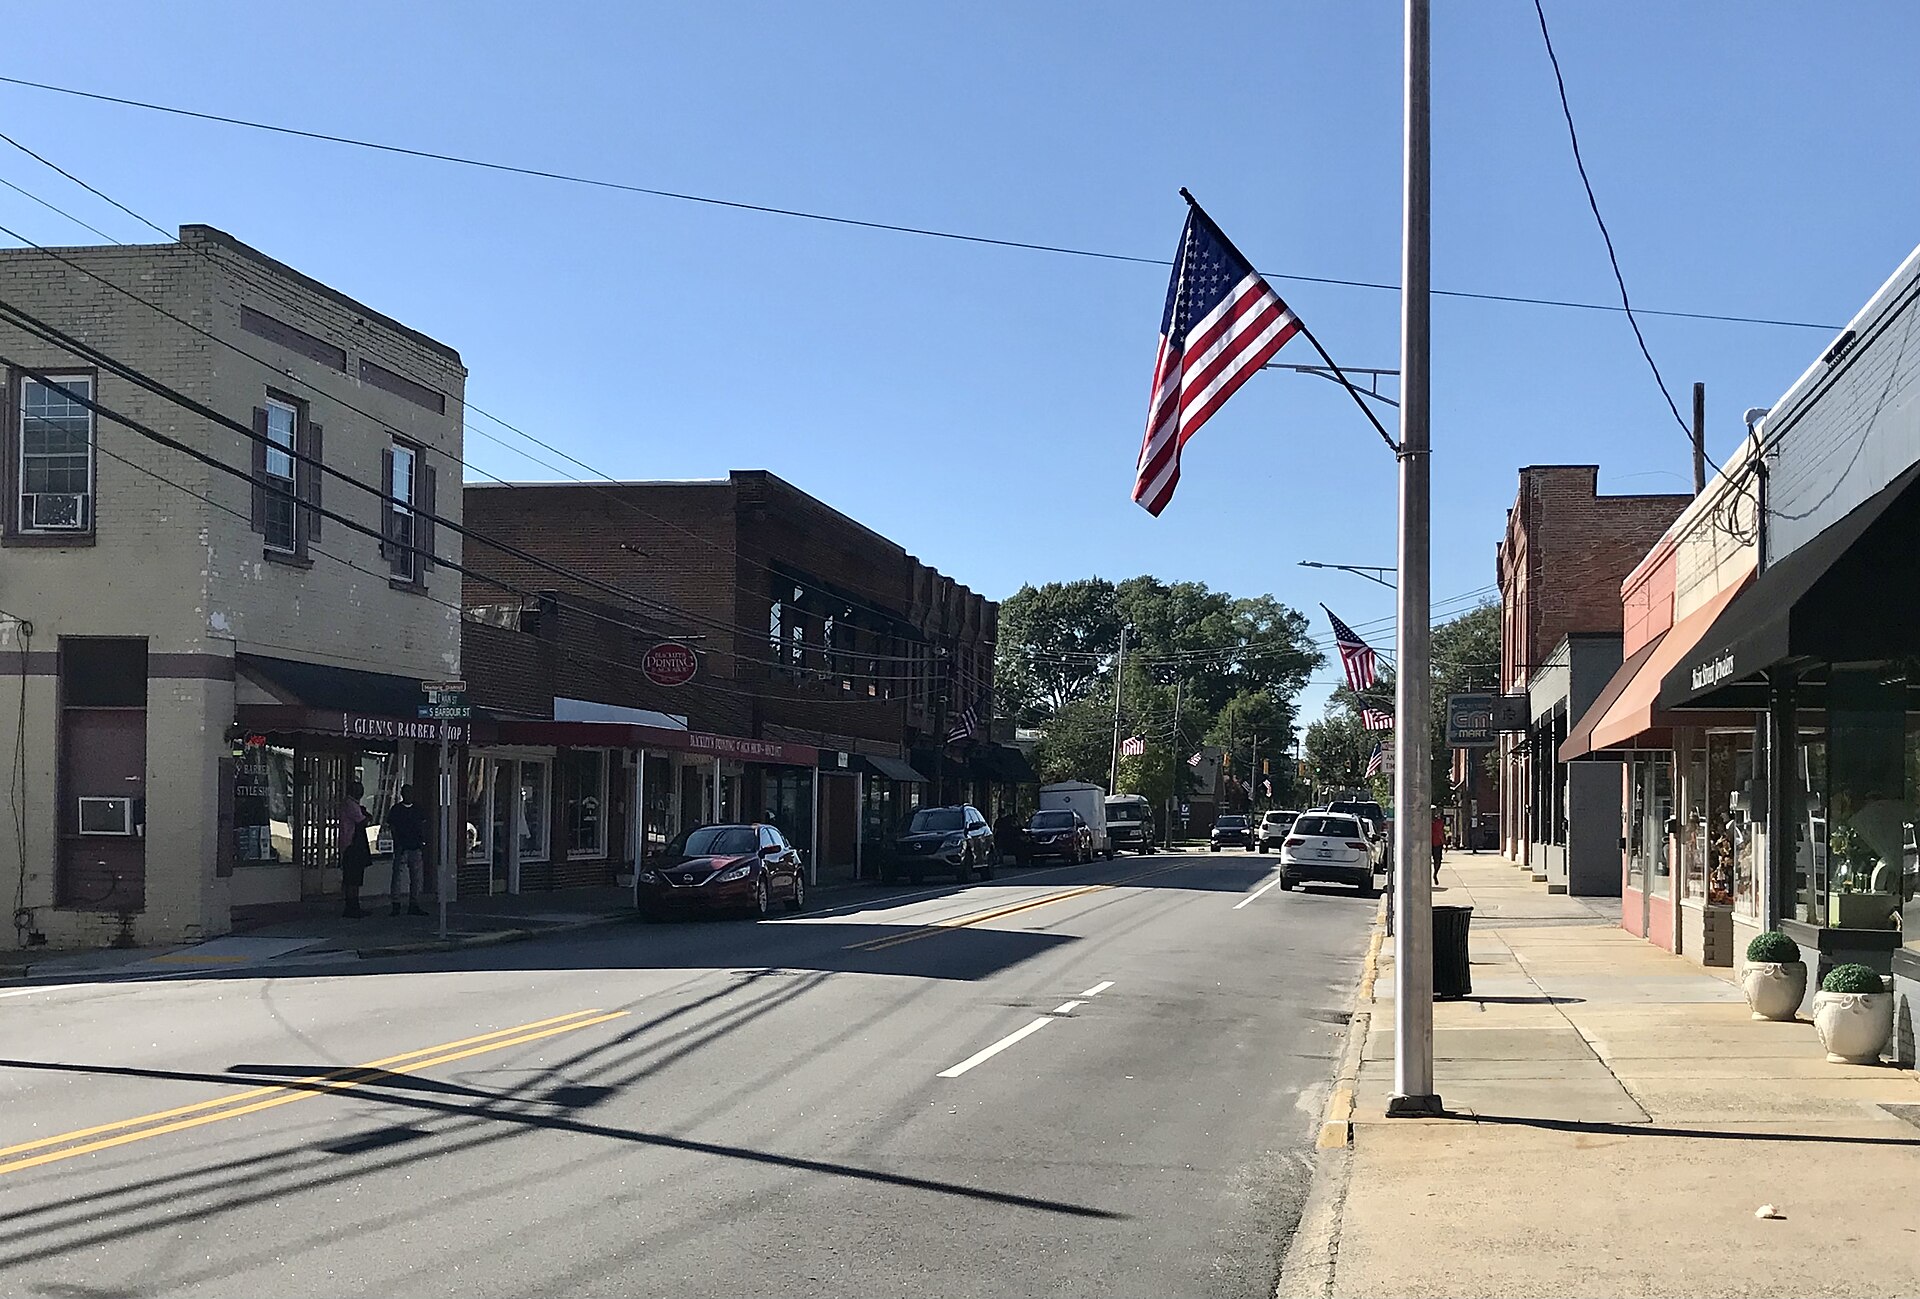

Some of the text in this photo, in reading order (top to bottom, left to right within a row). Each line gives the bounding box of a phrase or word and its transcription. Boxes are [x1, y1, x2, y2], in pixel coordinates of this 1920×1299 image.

[647, 656, 694, 668] PRINTING
[429, 707, 434, 717] S
[434, 707, 461, 717] BARBOUR
[462, 707, 471, 717] ST
[354, 718, 393, 736] GLEN'S
[397, 721, 435, 739] BARBER
[1459, 729, 1488, 738] MART
[236, 785, 258, 796] STYLE
